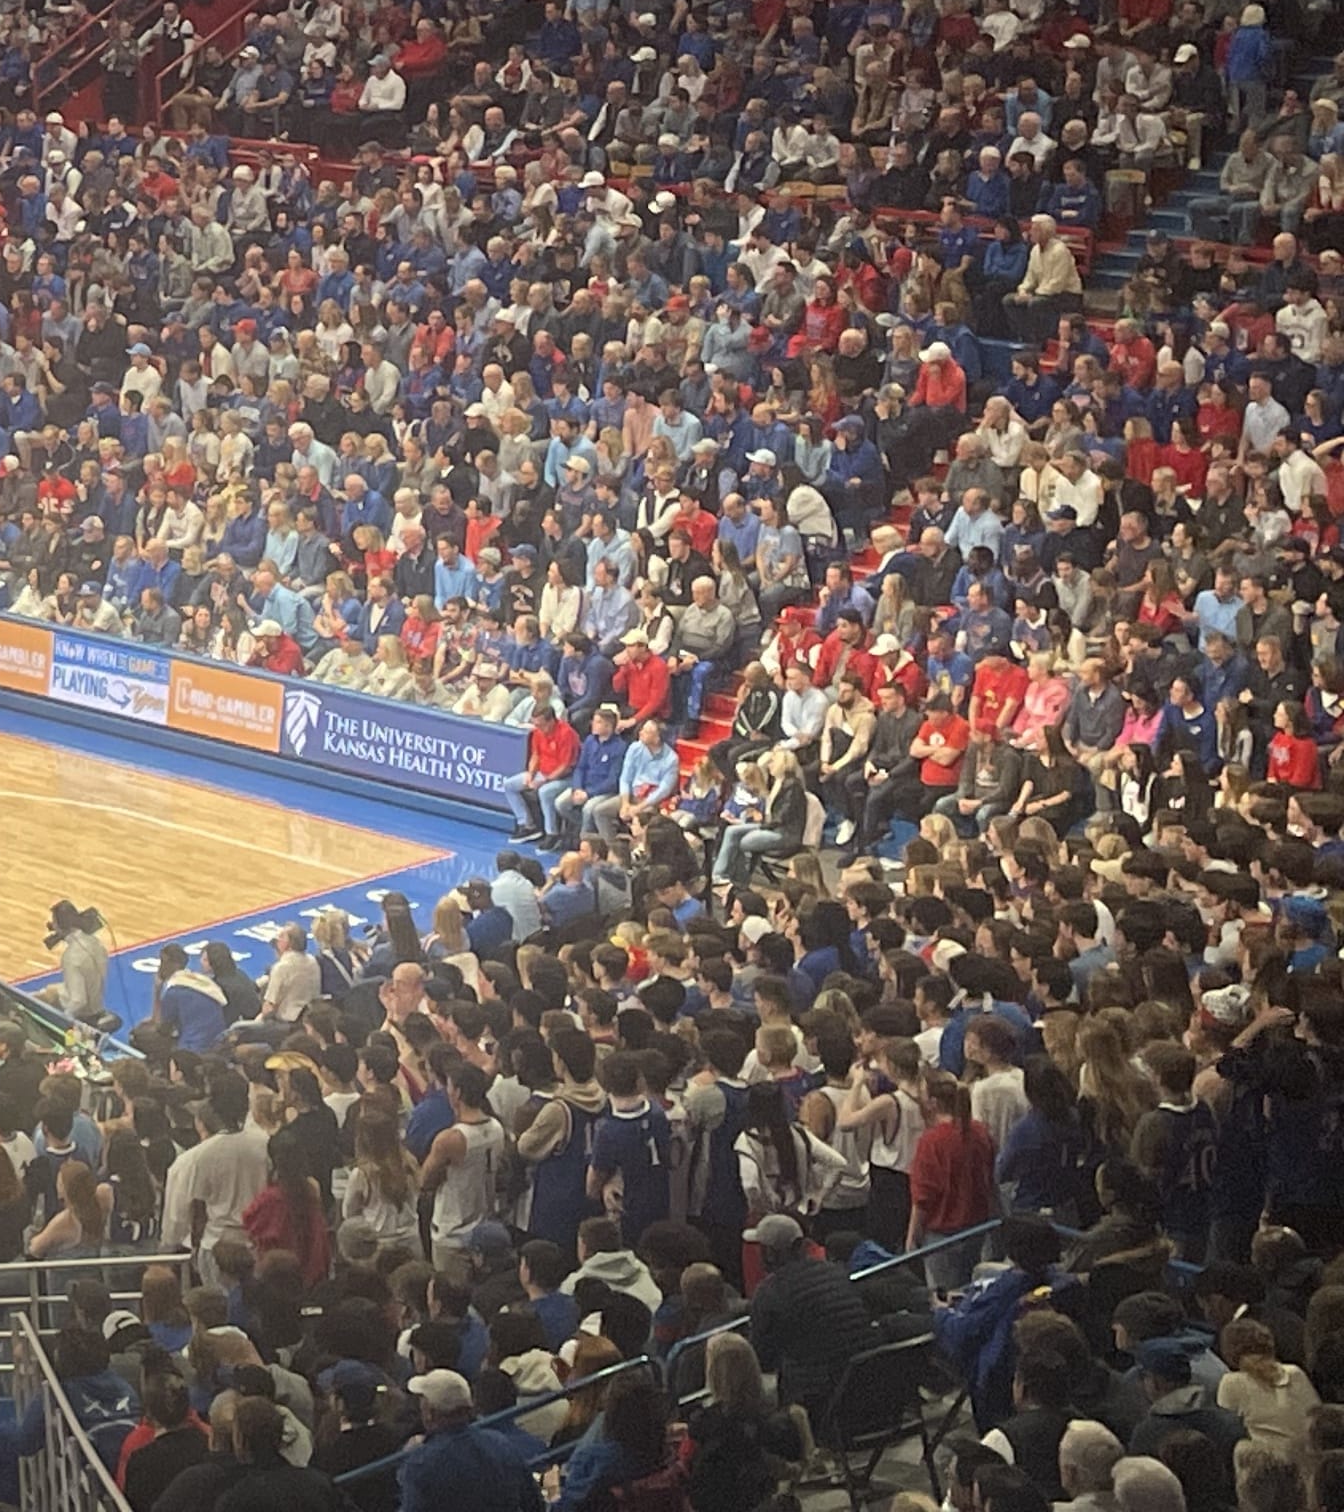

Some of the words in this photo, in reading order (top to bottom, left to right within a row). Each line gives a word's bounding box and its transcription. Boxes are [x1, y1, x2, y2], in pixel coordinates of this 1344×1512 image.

[87, 646, 116, 667] WHEN
[53, 664, 108, 700] PLAYING
[323, 731, 386, 765] KANSAS
[389, 747, 452, 780] HEALTH
[325, 710, 359, 737] THE
[362, 719, 461, 761] UNIVERSITY
[462, 744, 487, 767] OF
[647, 1136, 661, 1166] 1
